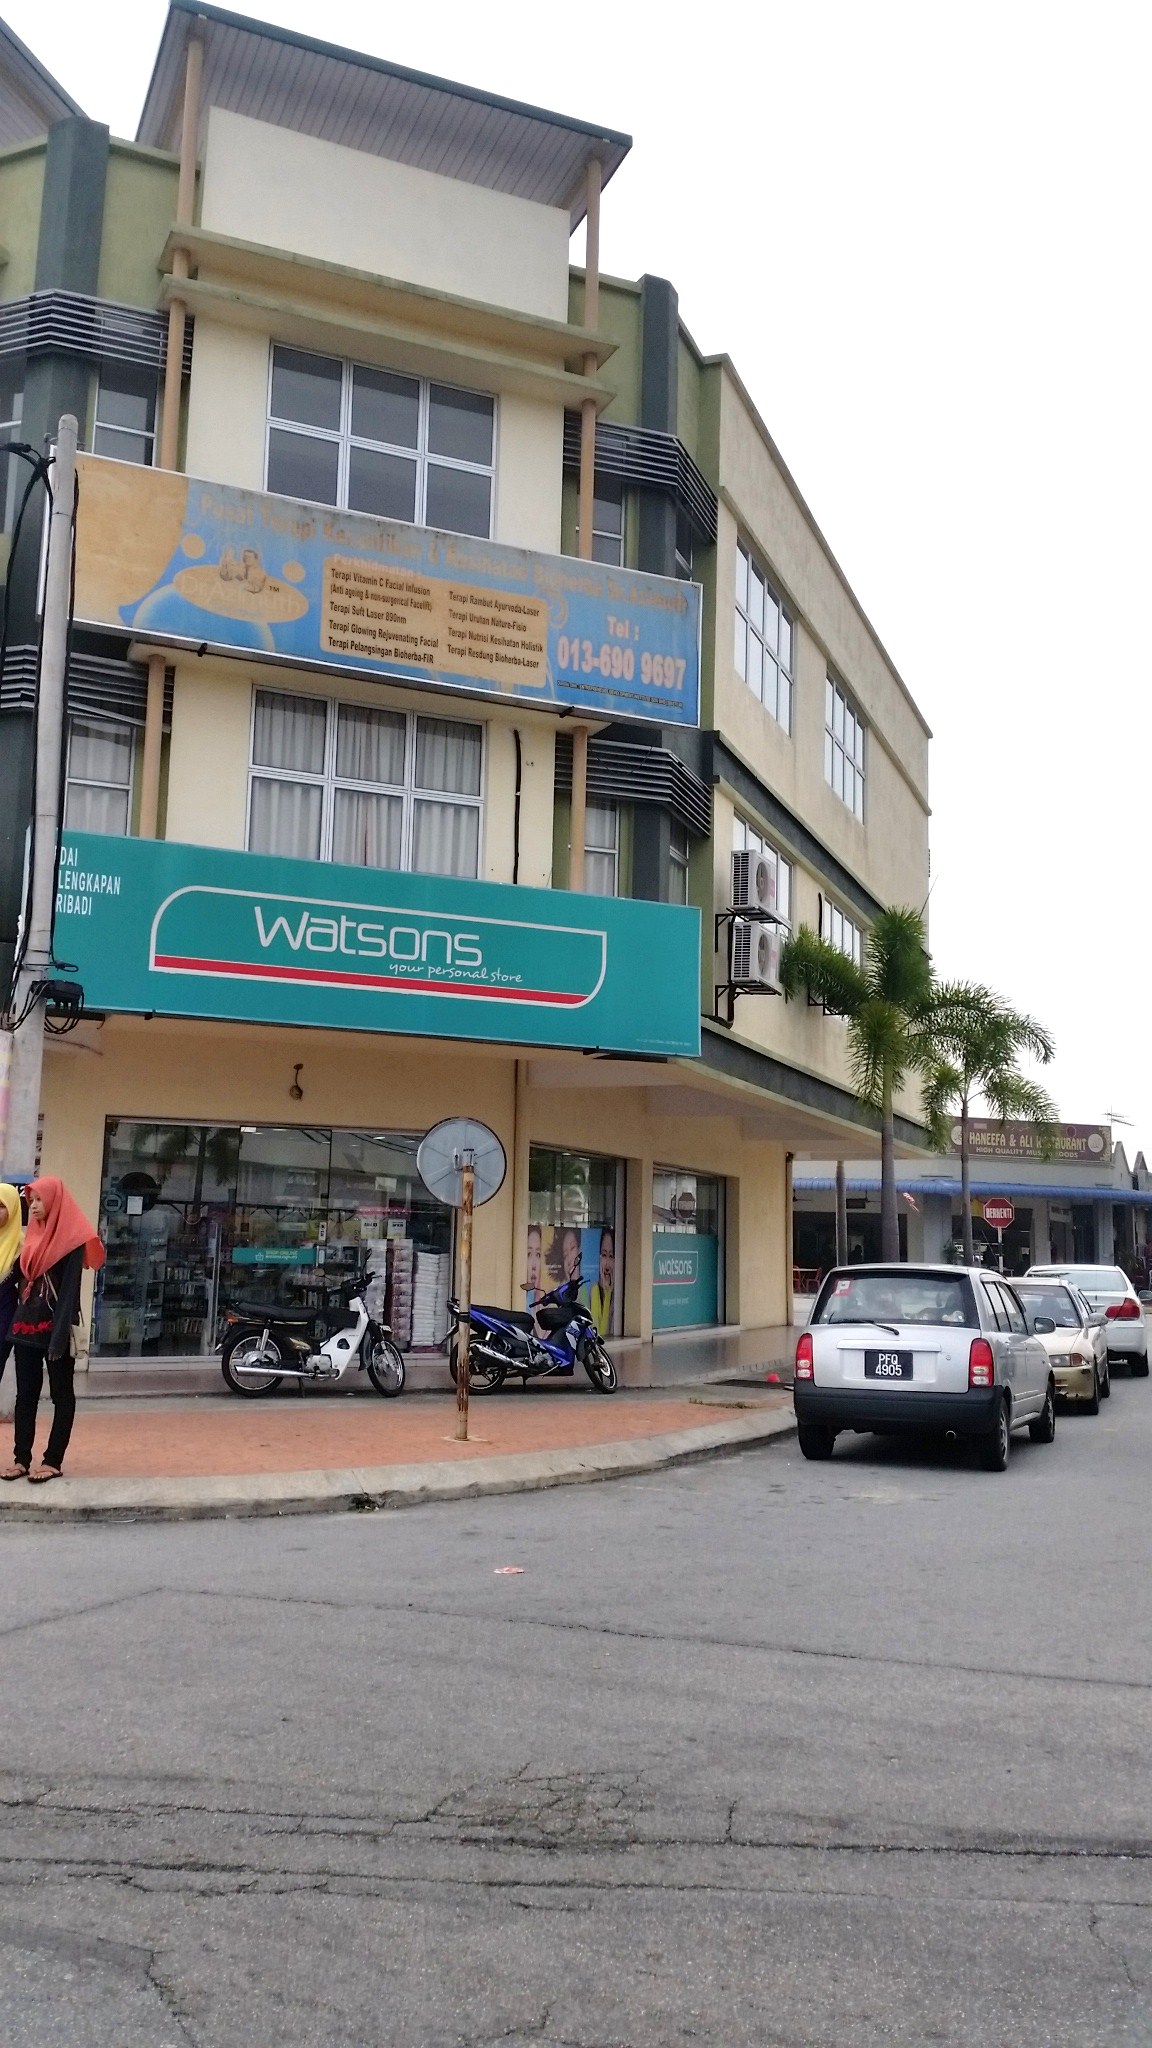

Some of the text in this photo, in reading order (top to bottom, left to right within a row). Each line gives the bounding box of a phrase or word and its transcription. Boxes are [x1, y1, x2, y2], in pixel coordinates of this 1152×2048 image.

[269, 585, 280, 593] TM
[331, 568, 431, 597] Terapi Vitamin C Facial Infusion
[365, 590, 370, 599] &
[449, 590, 540, 617] Terapi Rambut Ayurveda-Laser
[330, 601, 350, 615] Terapi
[366, 608, 384, 620] Laser
[385, 612, 407, 624] 890nm
[448, 608, 527, 632] Terapi Urutan Nature-Fisio
[329, 619, 439, 648] Terapi Glowing Rejuvenating Facial
[448, 626, 544, 653] Terapi Nutrisi Kesihatan Holistik
[606, 615, 640, 641] Tel :
[328, 636, 434, 664] Terapi Pelangsingan Bioherba-FIR
[447, 643, 540, 668] Terapi Resdung Bioherba-Laser
[557, 635, 686, 691] 013-690 9697
[55, 846, 78, 866] DAI
[389, 963, 523, 983] your personal store
[969, 1131, 1087, 1151] HANEEFA & ALI RAURANT
[976, 1146, 992, 1154] HIGH
[995, 1147, 1024, 1155] QUALITY
[985, 1207, 1012, 1219] BERHENTI
[875, 1364, 902, 1376] 4905
[878, 1353, 899, 1365] PFQ
